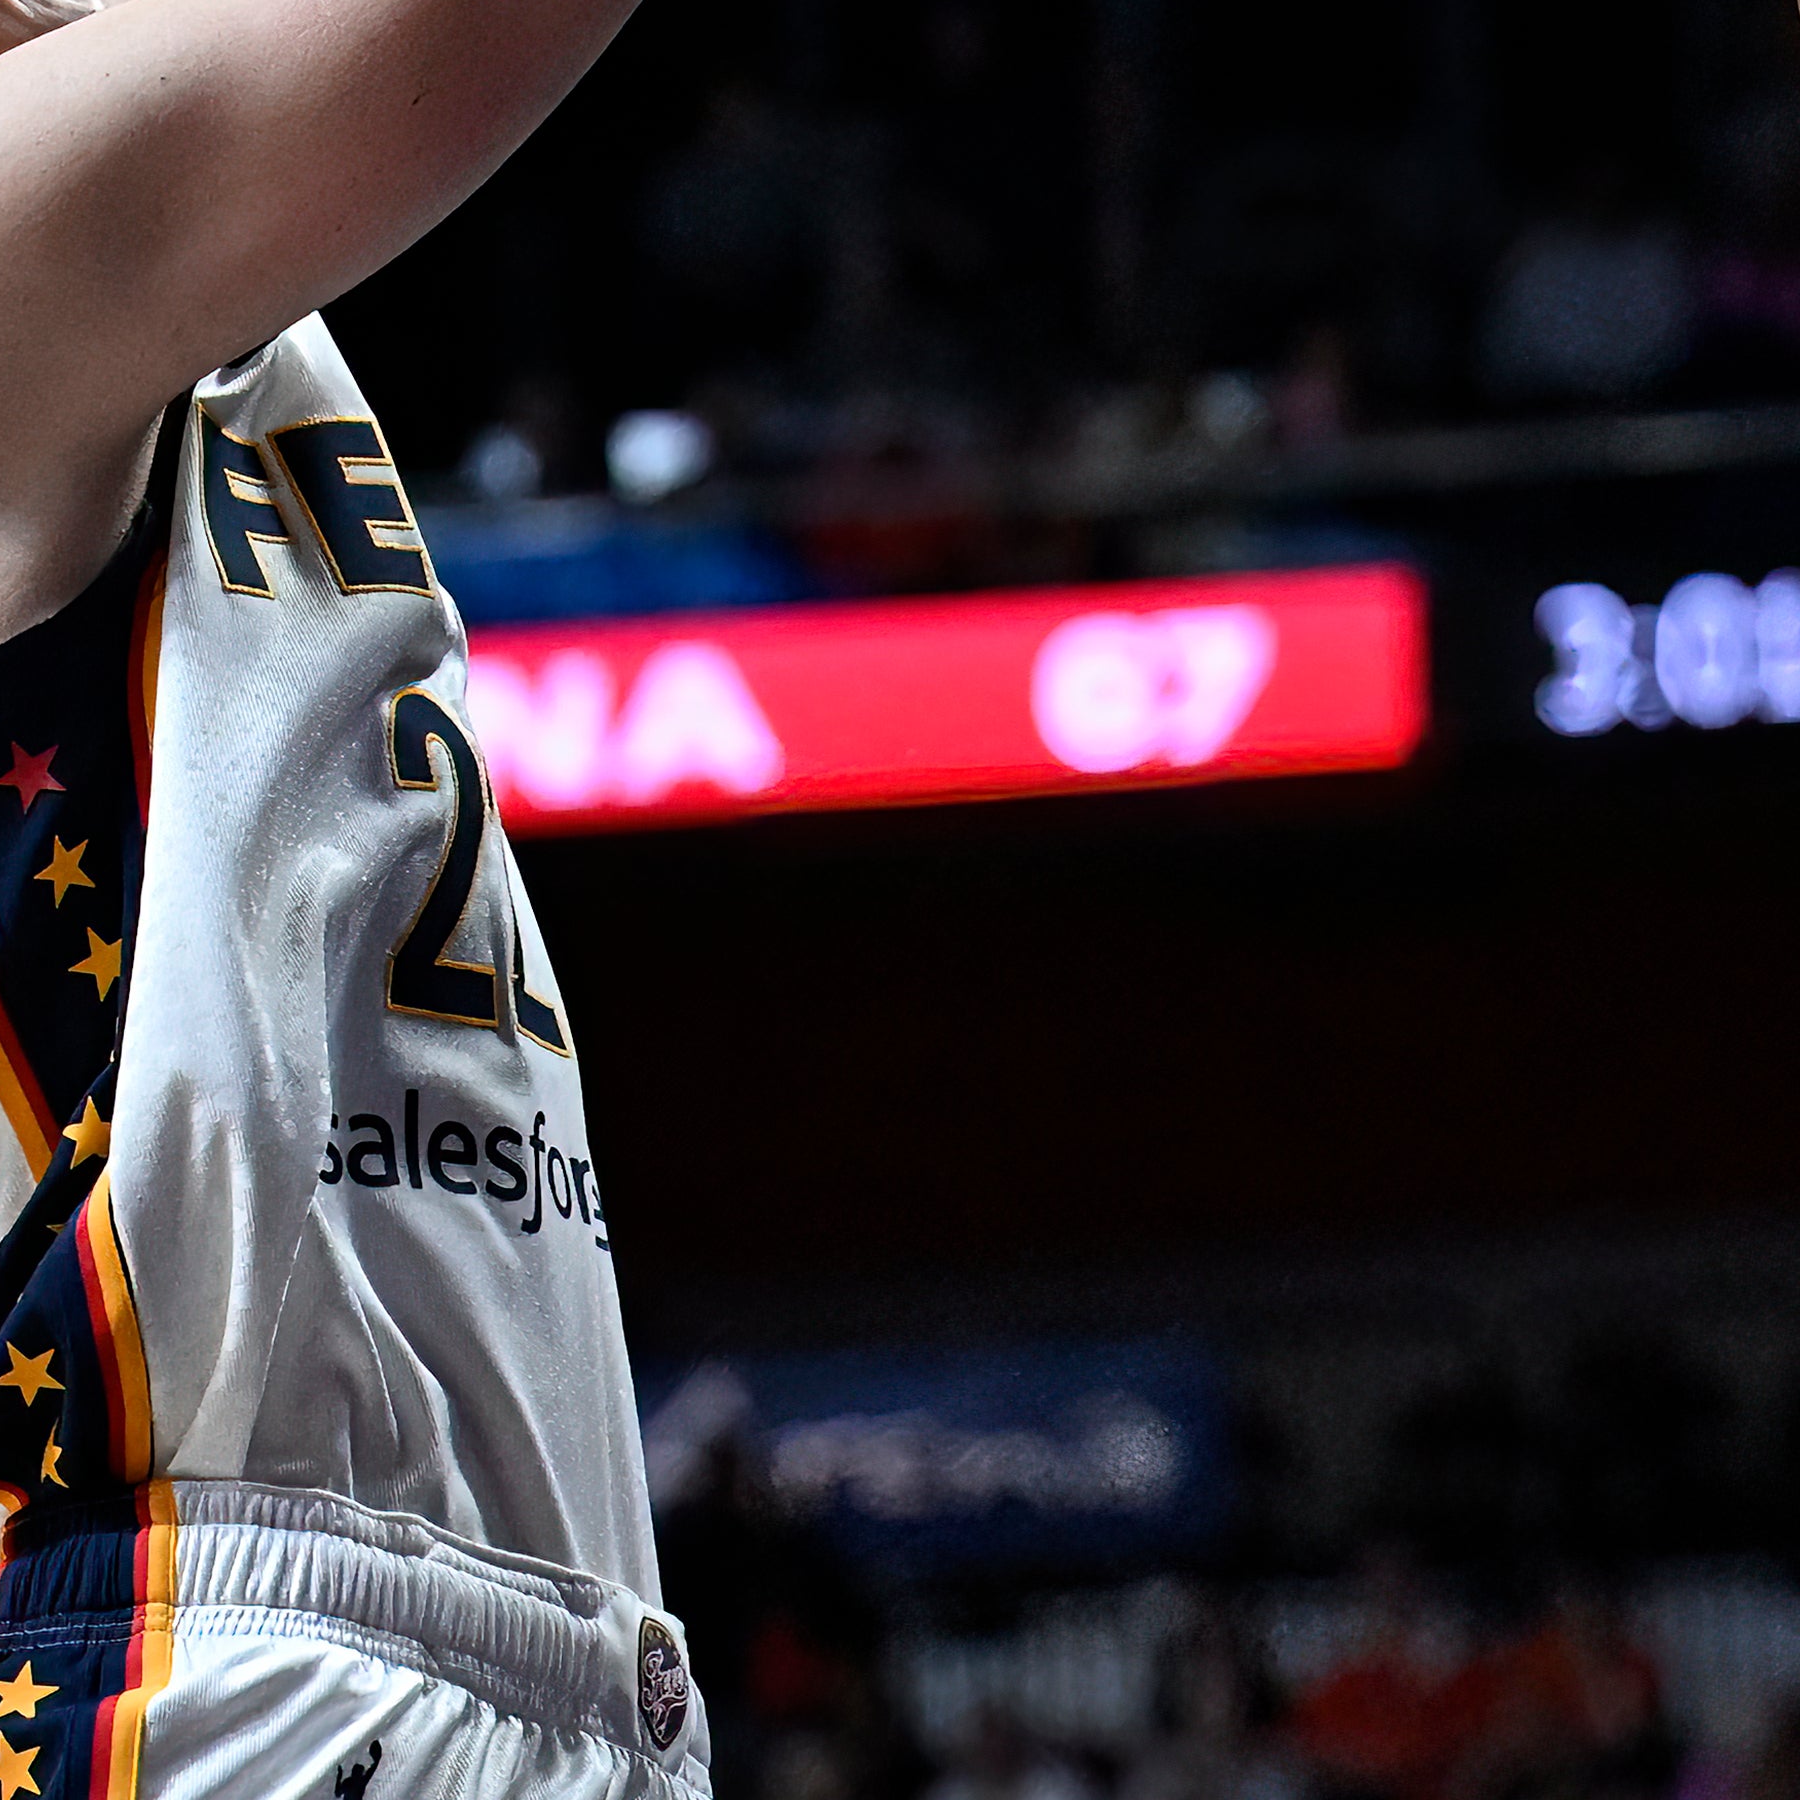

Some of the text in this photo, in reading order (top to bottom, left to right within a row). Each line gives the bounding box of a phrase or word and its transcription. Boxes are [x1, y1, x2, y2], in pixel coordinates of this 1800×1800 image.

[198, 402, 436, 600] FE
[384, 685, 575, 1059] 2
[318, 1087, 611, 1253] salesfor
